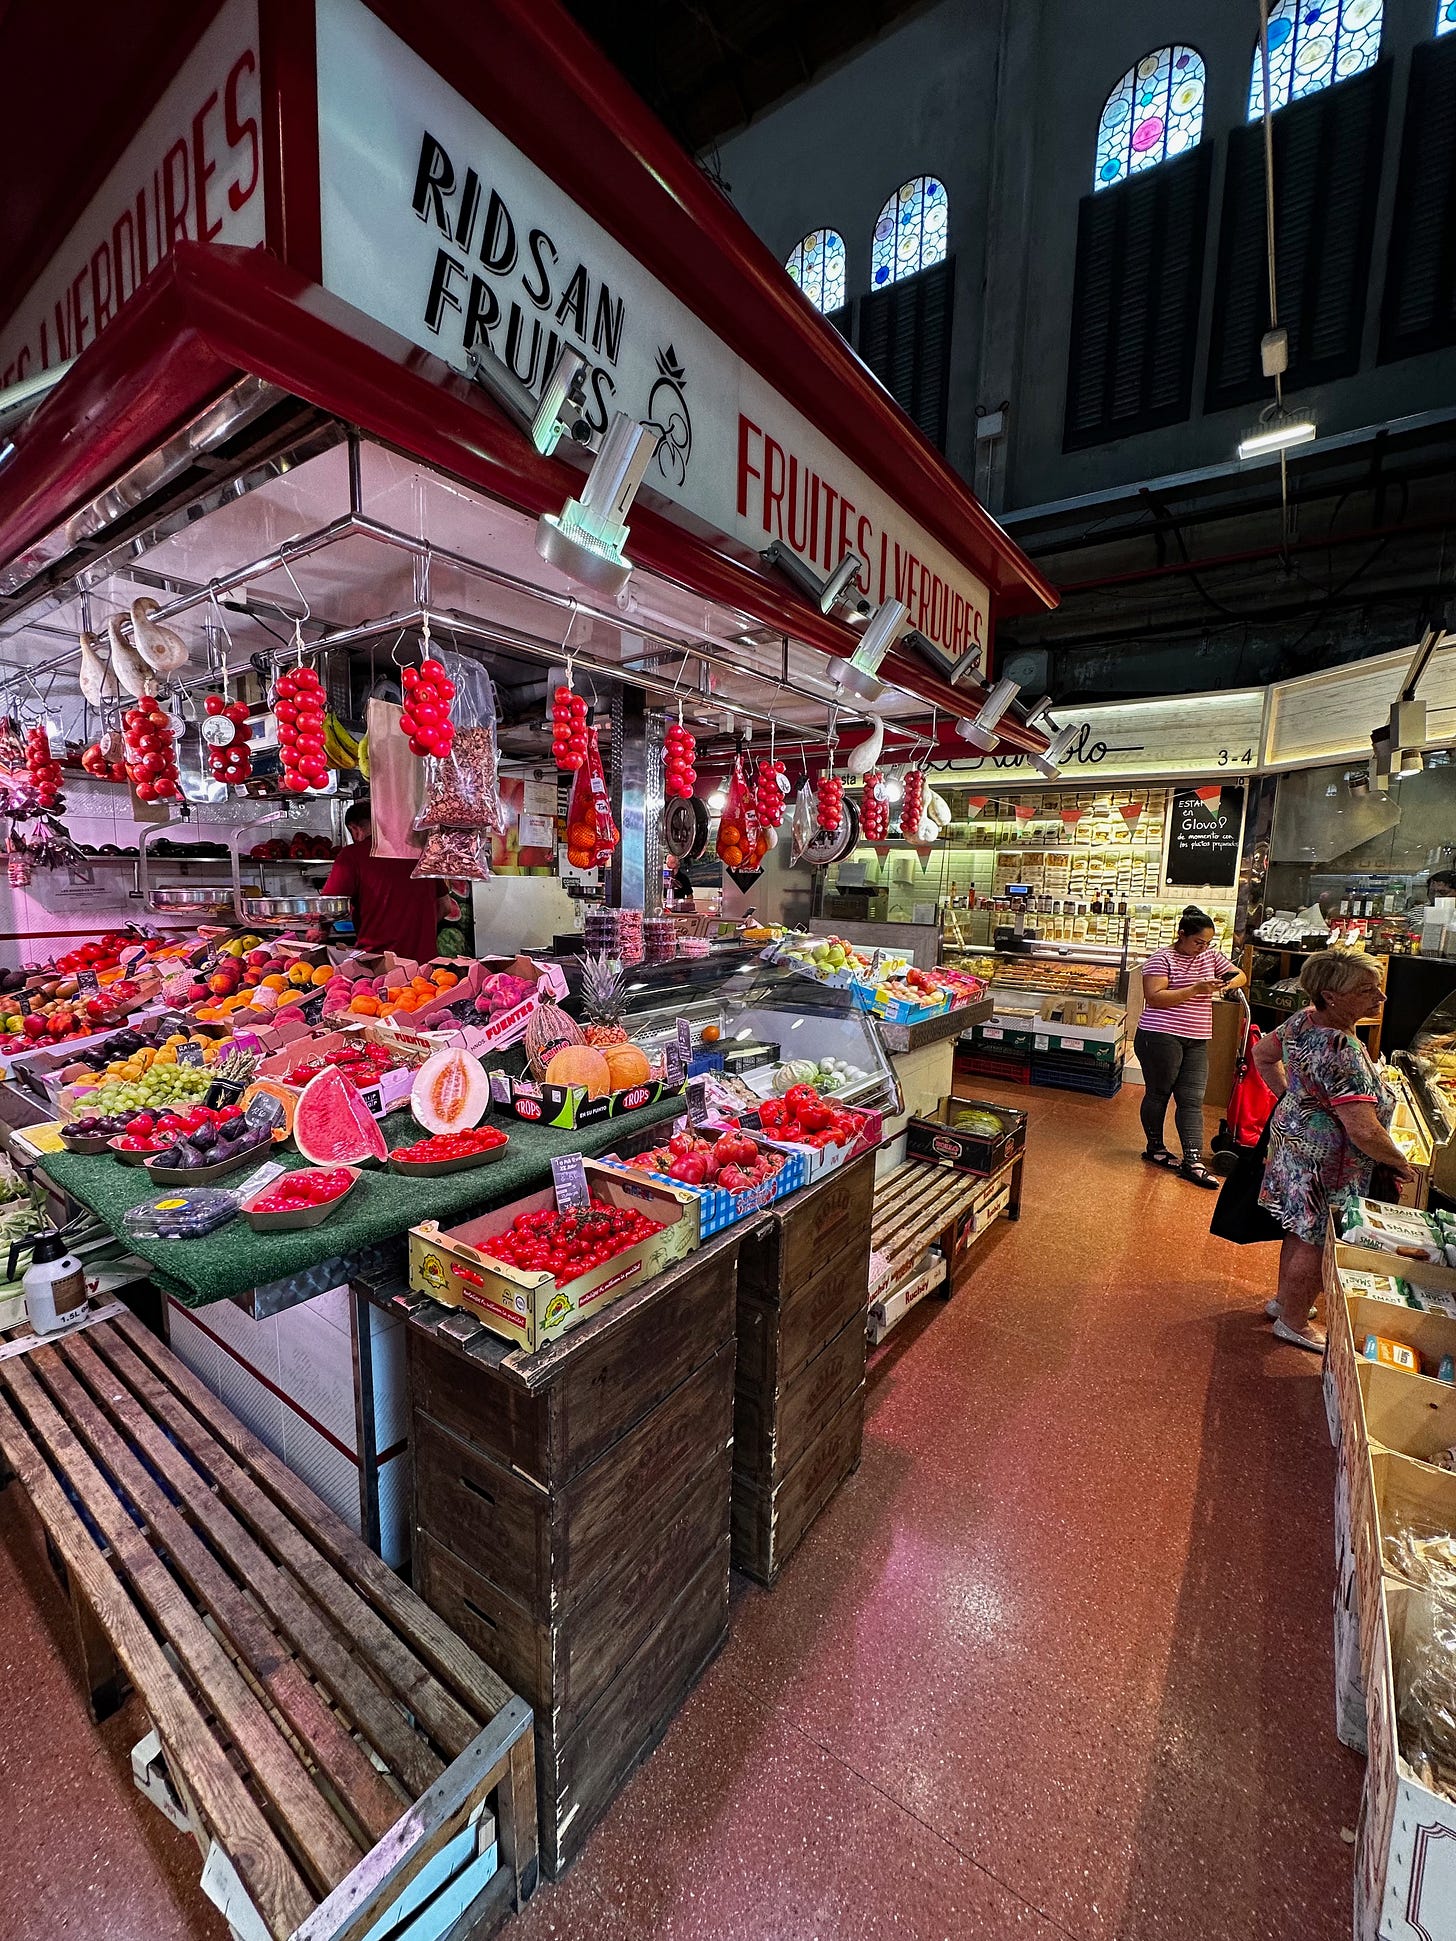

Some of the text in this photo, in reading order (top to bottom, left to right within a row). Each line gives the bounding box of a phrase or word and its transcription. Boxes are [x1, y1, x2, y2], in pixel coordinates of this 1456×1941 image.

[412, 130, 627, 366] RIDSAN
[424, 248, 618, 436] FRUIS
[737, 412, 873, 596] FRUITES
[894, 541, 983, 670] VERDURES
[1177, 832, 1186, 840] de
[1188, 831, 1220, 840] momento
[485, 1001, 535, 1040] FUENTES
[394, 1032, 430, 1048] FUENTES
[624, 1088, 650, 1107] TROPS
[516, 1101, 542, 1118] TROPS
[1383, 1206, 1421, 1218] SMART
[1386, 1223, 1425, 1237] SMART
[1360, 1236, 1384, 1249] SMART
[905, 1280, 929, 1304] Ruchey
[61, 1312, 80, 1322] 1.5L
